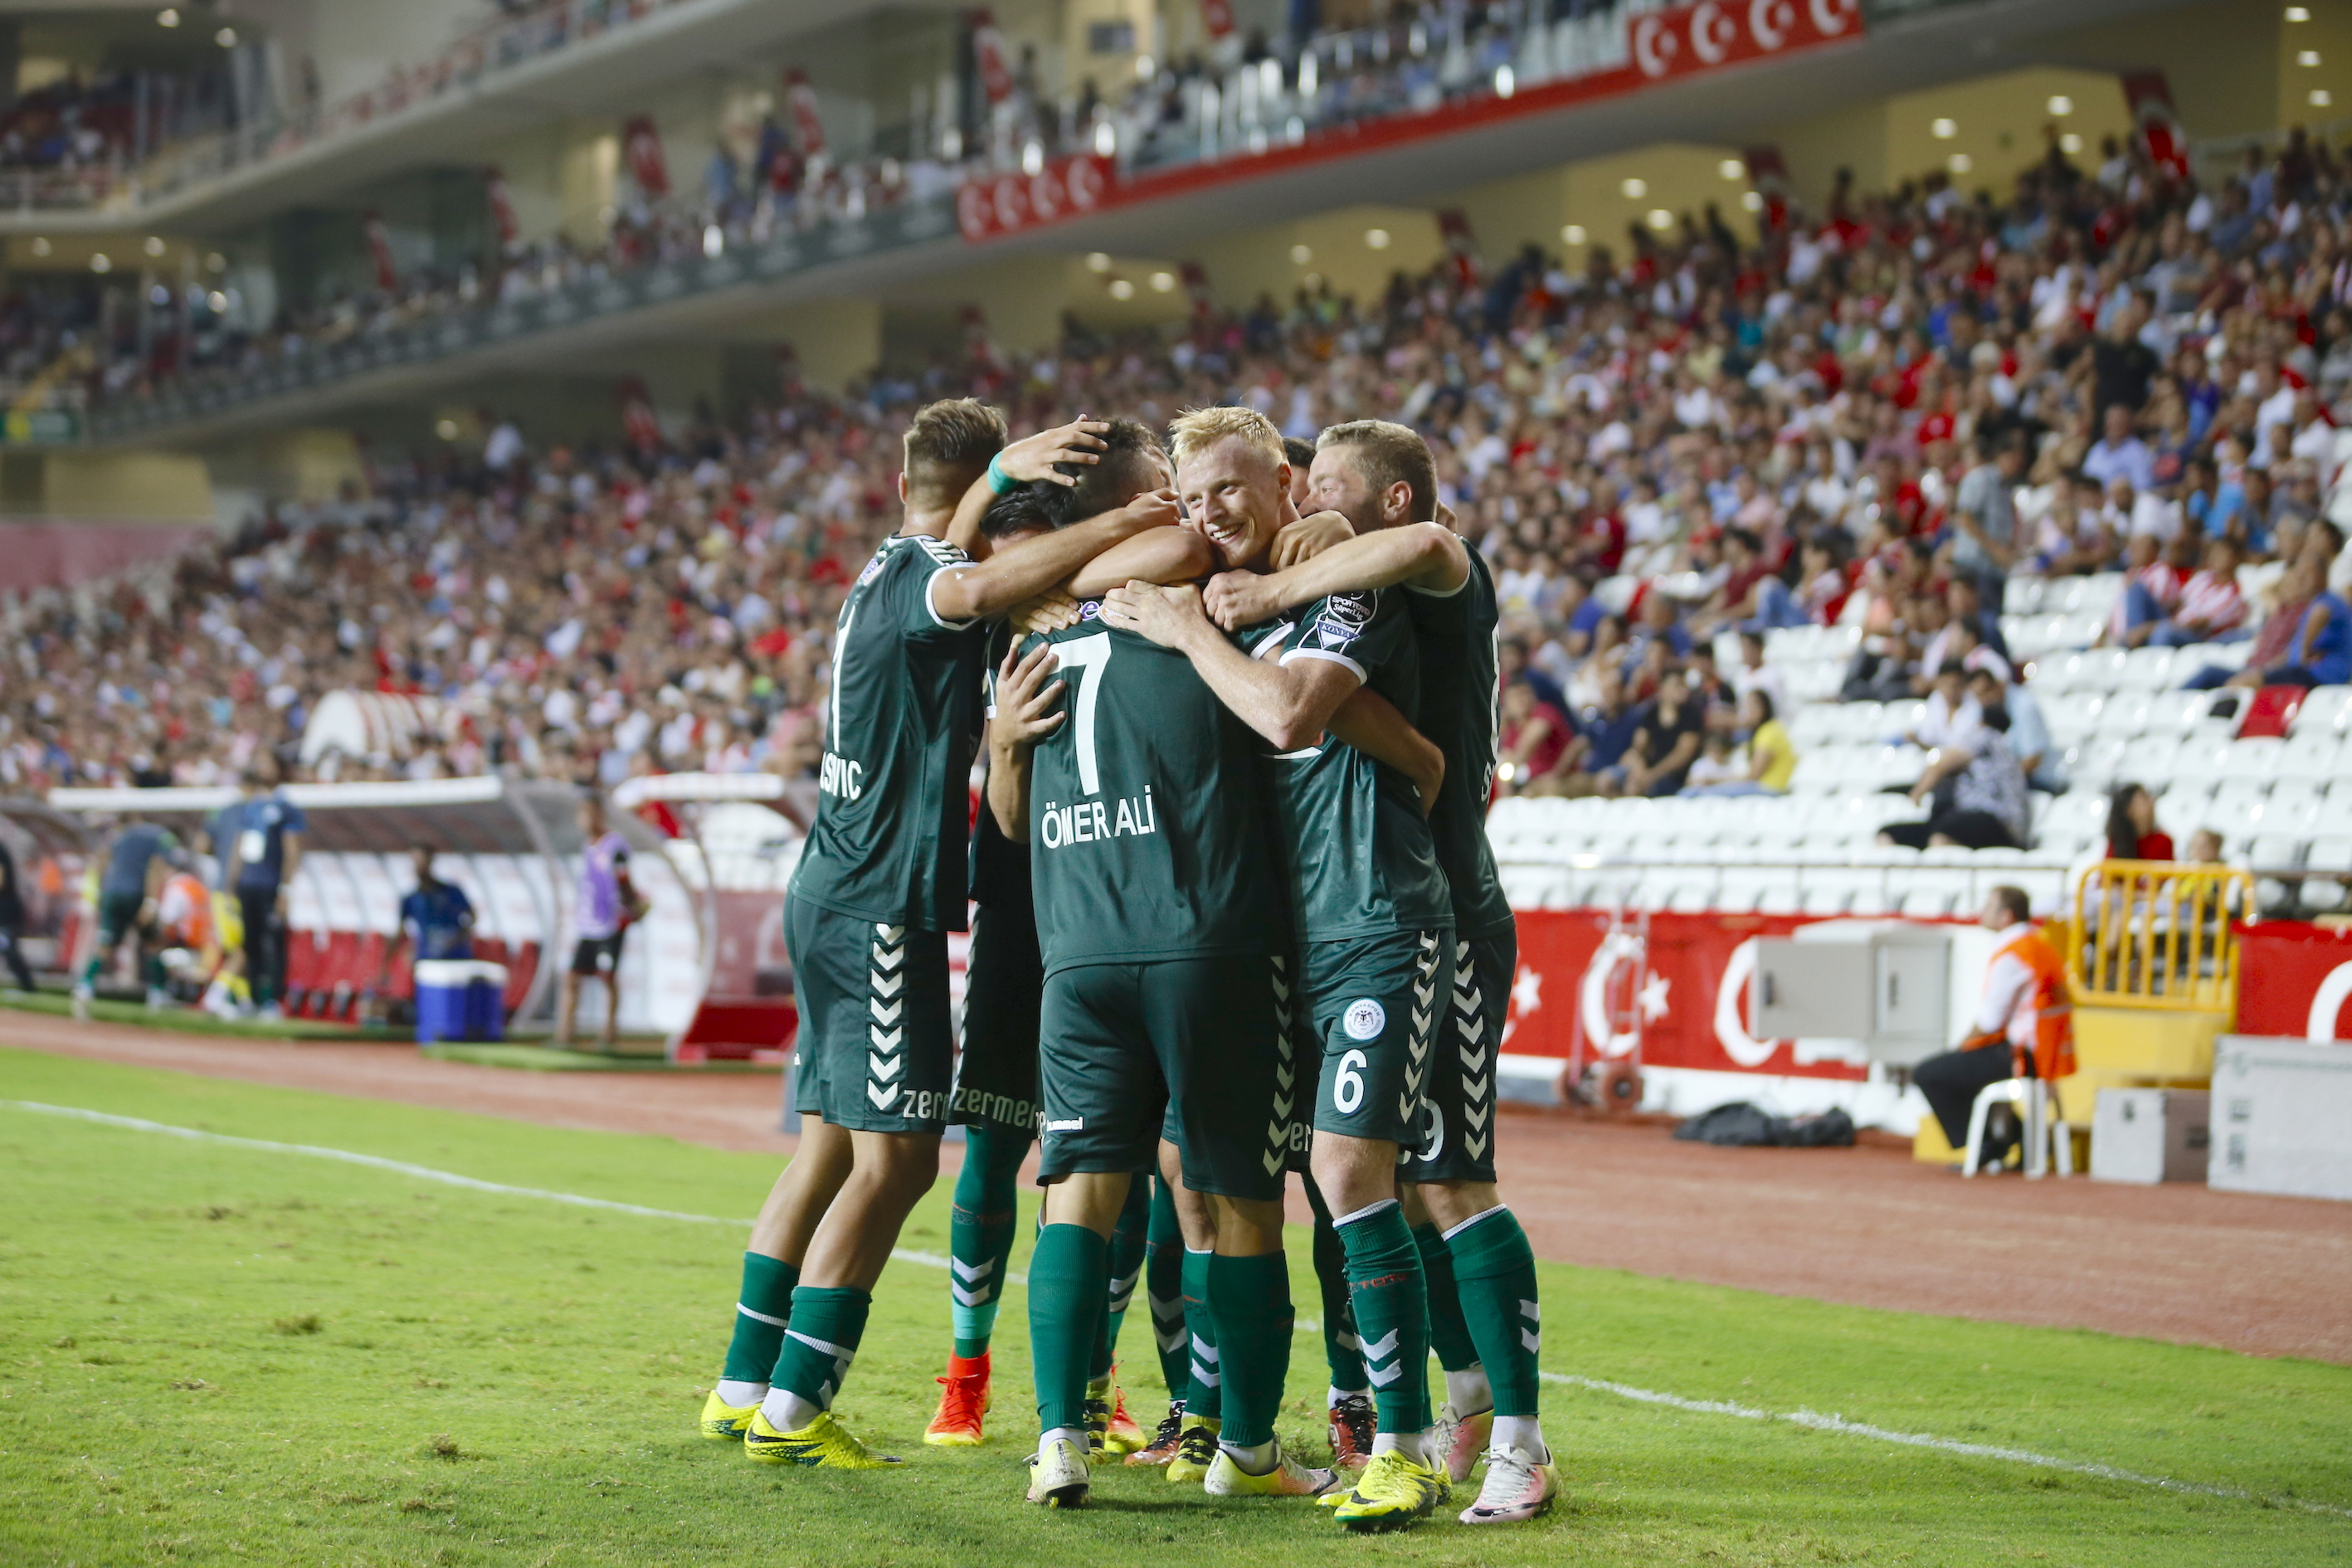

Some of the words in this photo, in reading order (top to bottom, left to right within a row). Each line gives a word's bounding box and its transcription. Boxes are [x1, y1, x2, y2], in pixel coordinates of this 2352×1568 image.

[1321, 623, 1351, 638] KONYA
[1049, 631, 1113, 796] 7
[1041, 801, 1112, 850] ÖMER
[1113, 784, 1156, 838] ALİ
[1348, 1002, 1381, 1018] KONYASPOR
[1332, 1048, 1368, 1114] 6
